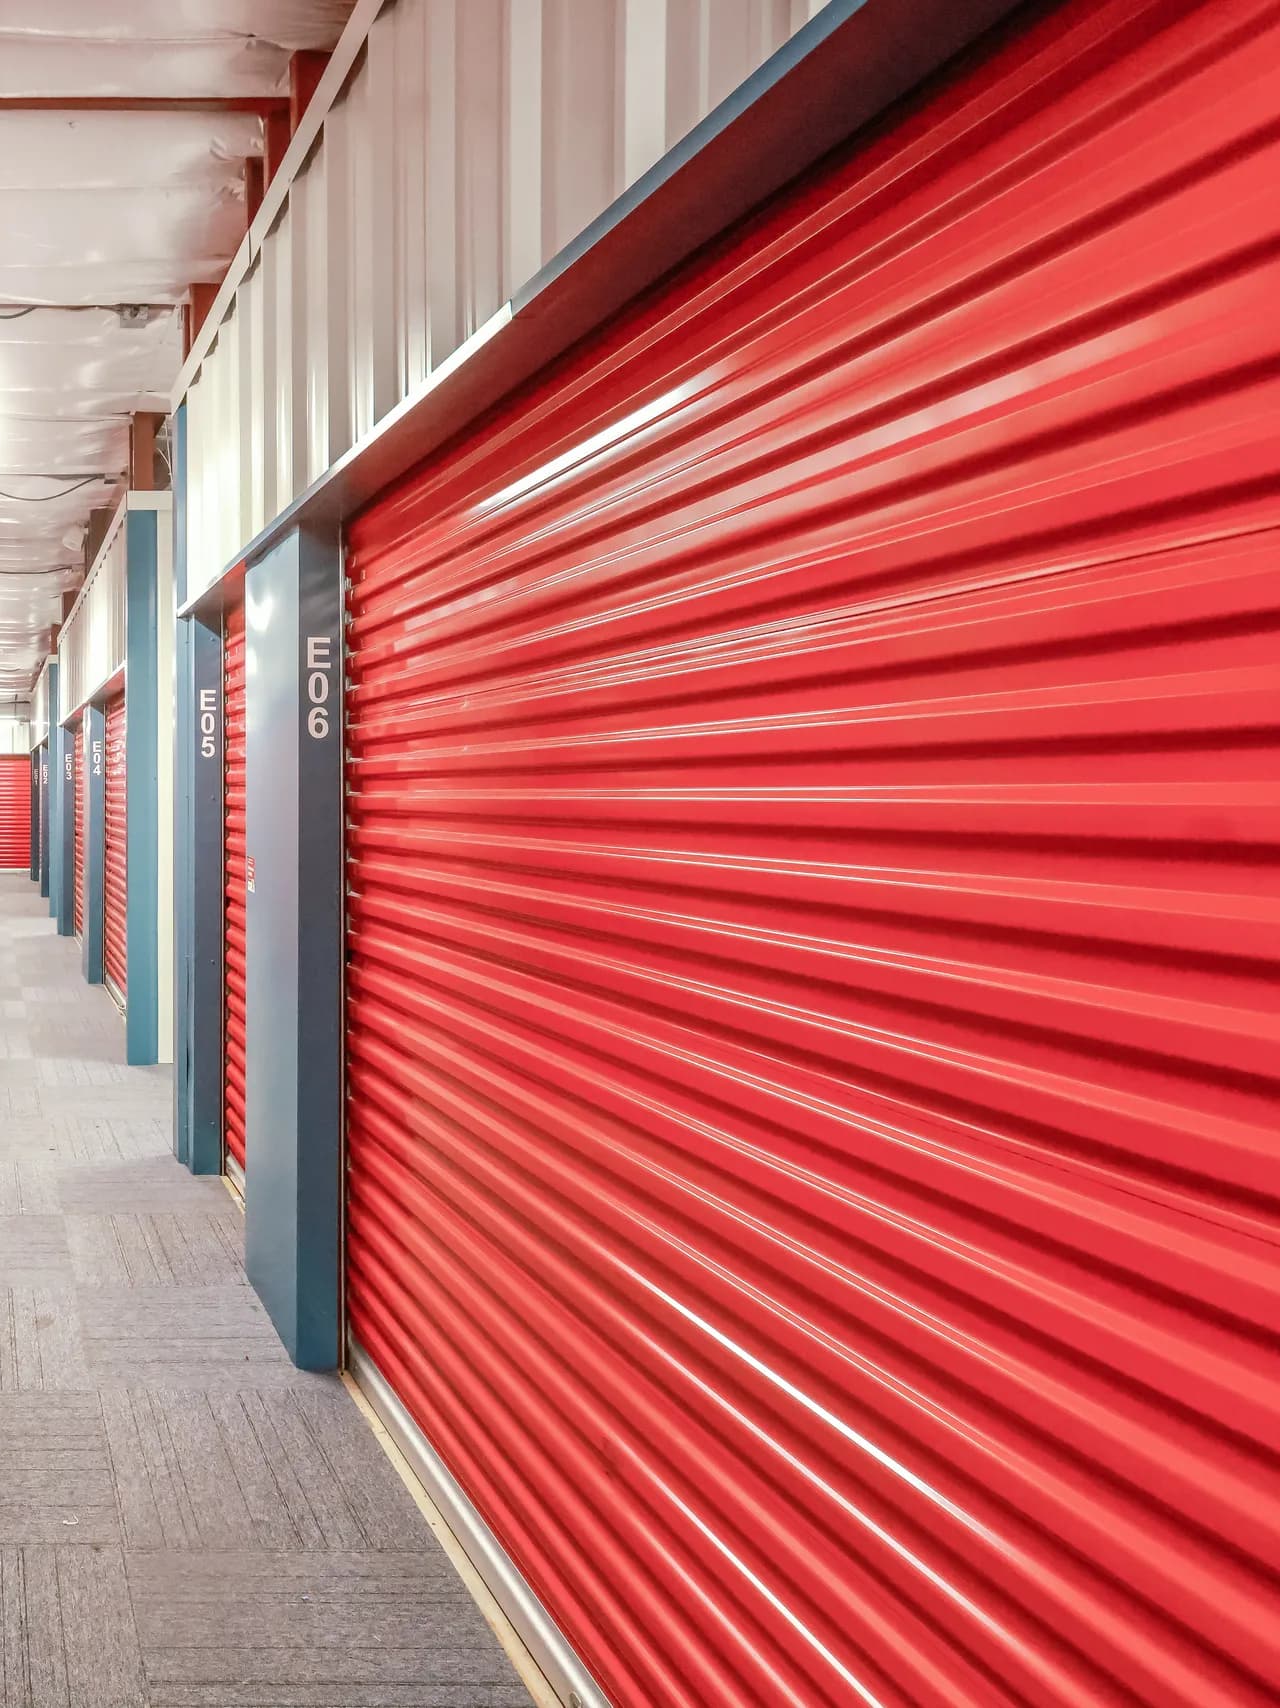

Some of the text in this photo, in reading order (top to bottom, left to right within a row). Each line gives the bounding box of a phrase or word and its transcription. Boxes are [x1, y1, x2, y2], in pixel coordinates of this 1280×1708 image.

[307, 637, 331, 739] E06
[92, 741, 101, 775] E04
[200, 690, 216, 758] E05
